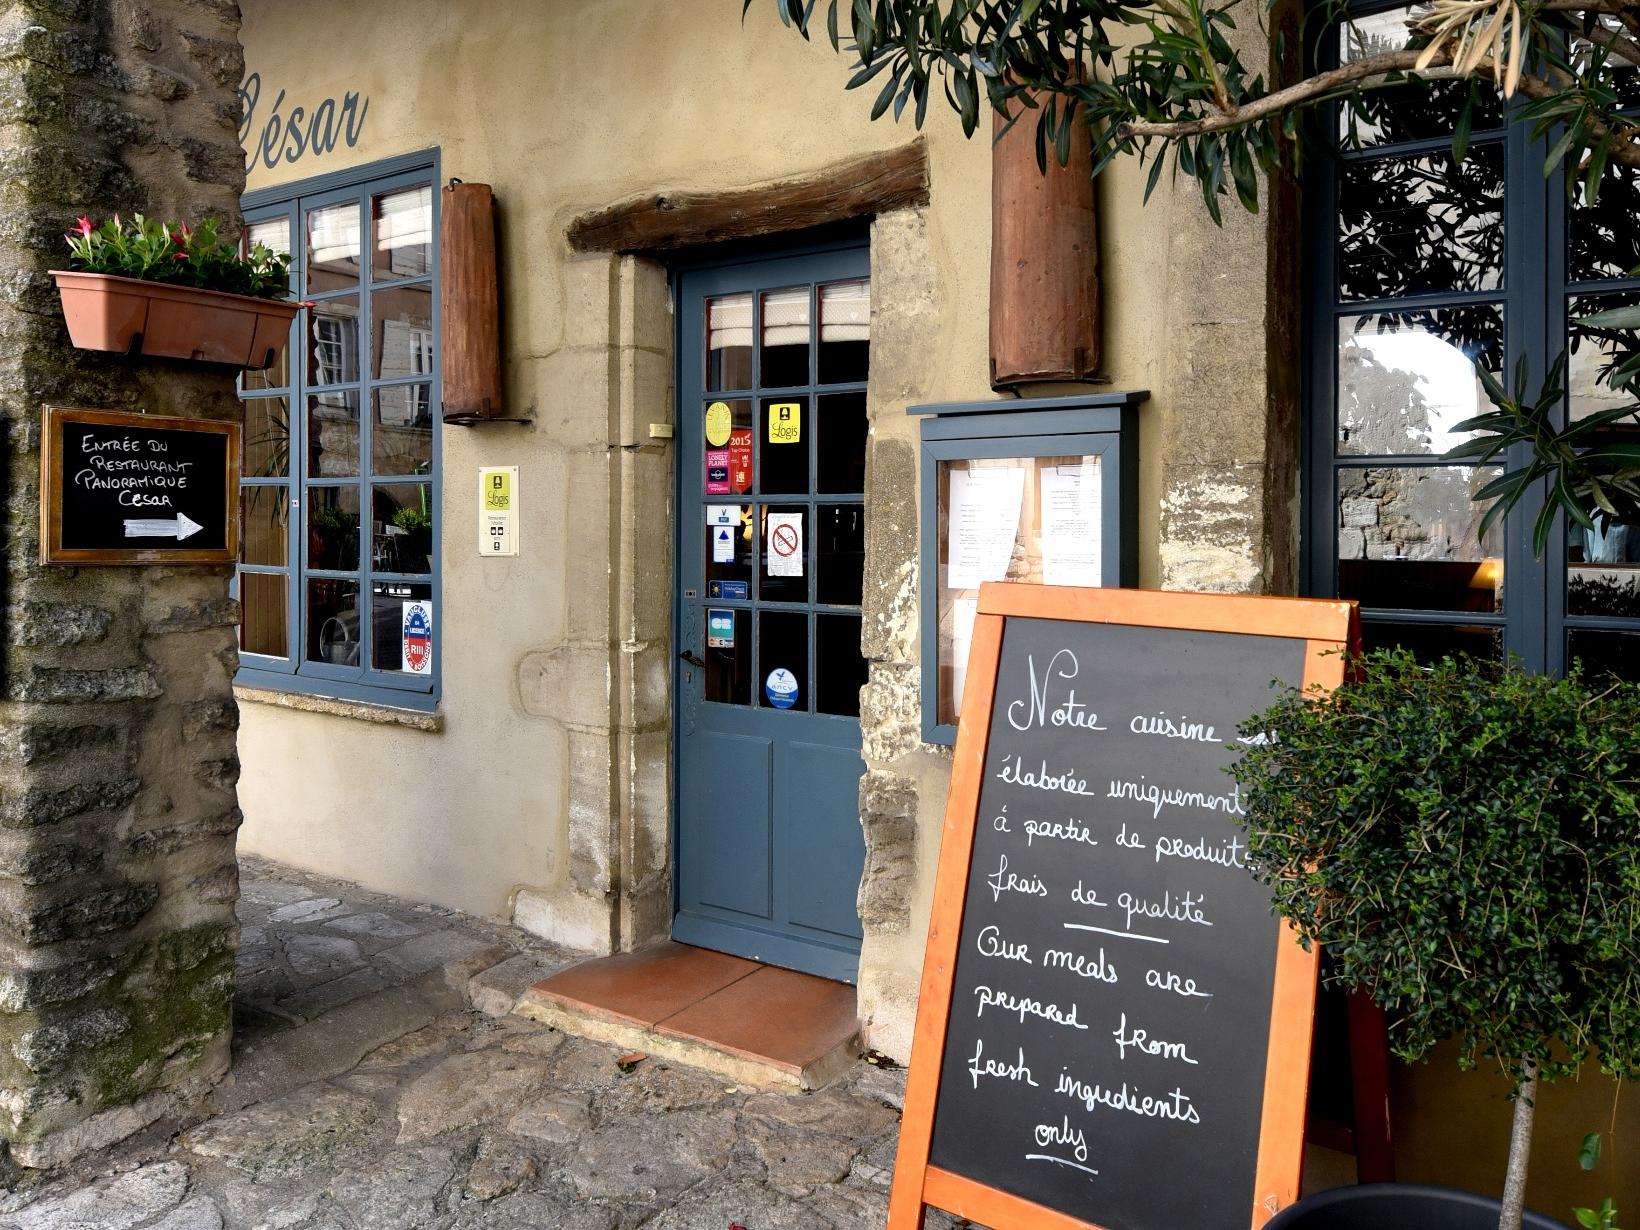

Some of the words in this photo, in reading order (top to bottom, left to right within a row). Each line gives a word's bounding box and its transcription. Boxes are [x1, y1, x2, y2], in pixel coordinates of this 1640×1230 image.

[730, 435, 751, 446] 2015
[772, 421, 798, 440] Logis
[90, 455, 193, 473] RESTAURANT
[487, 490, 509, 508] Logis
[405, 605, 430, 629] VAUCLUSE
[1007, 649, 1107, 731] Notre
[1130, 711, 1222, 742] cuisine
[997, 754, 1095, 796] élaborée
[1107, 775, 1249, 819] uniquement
[1024, 818, 1098, 846] partir
[1116, 823, 1146, 849] de
[988, 854, 1048, 902] frais
[1071, 880, 1107, 906] de
[1117, 891, 1213, 930] qualité
[977, 926, 1033, 964] Our
[1044, 947, 1118, 983] meals
[1146, 969, 1213, 997] are
[974, 986, 1088, 1029] prepared
[1113, 1013, 1198, 1064] from
[968, 1039, 1039, 1089] fresh
[1054, 1067, 1200, 1124] ingredients
[1035, 1114, 1087, 1161] only
